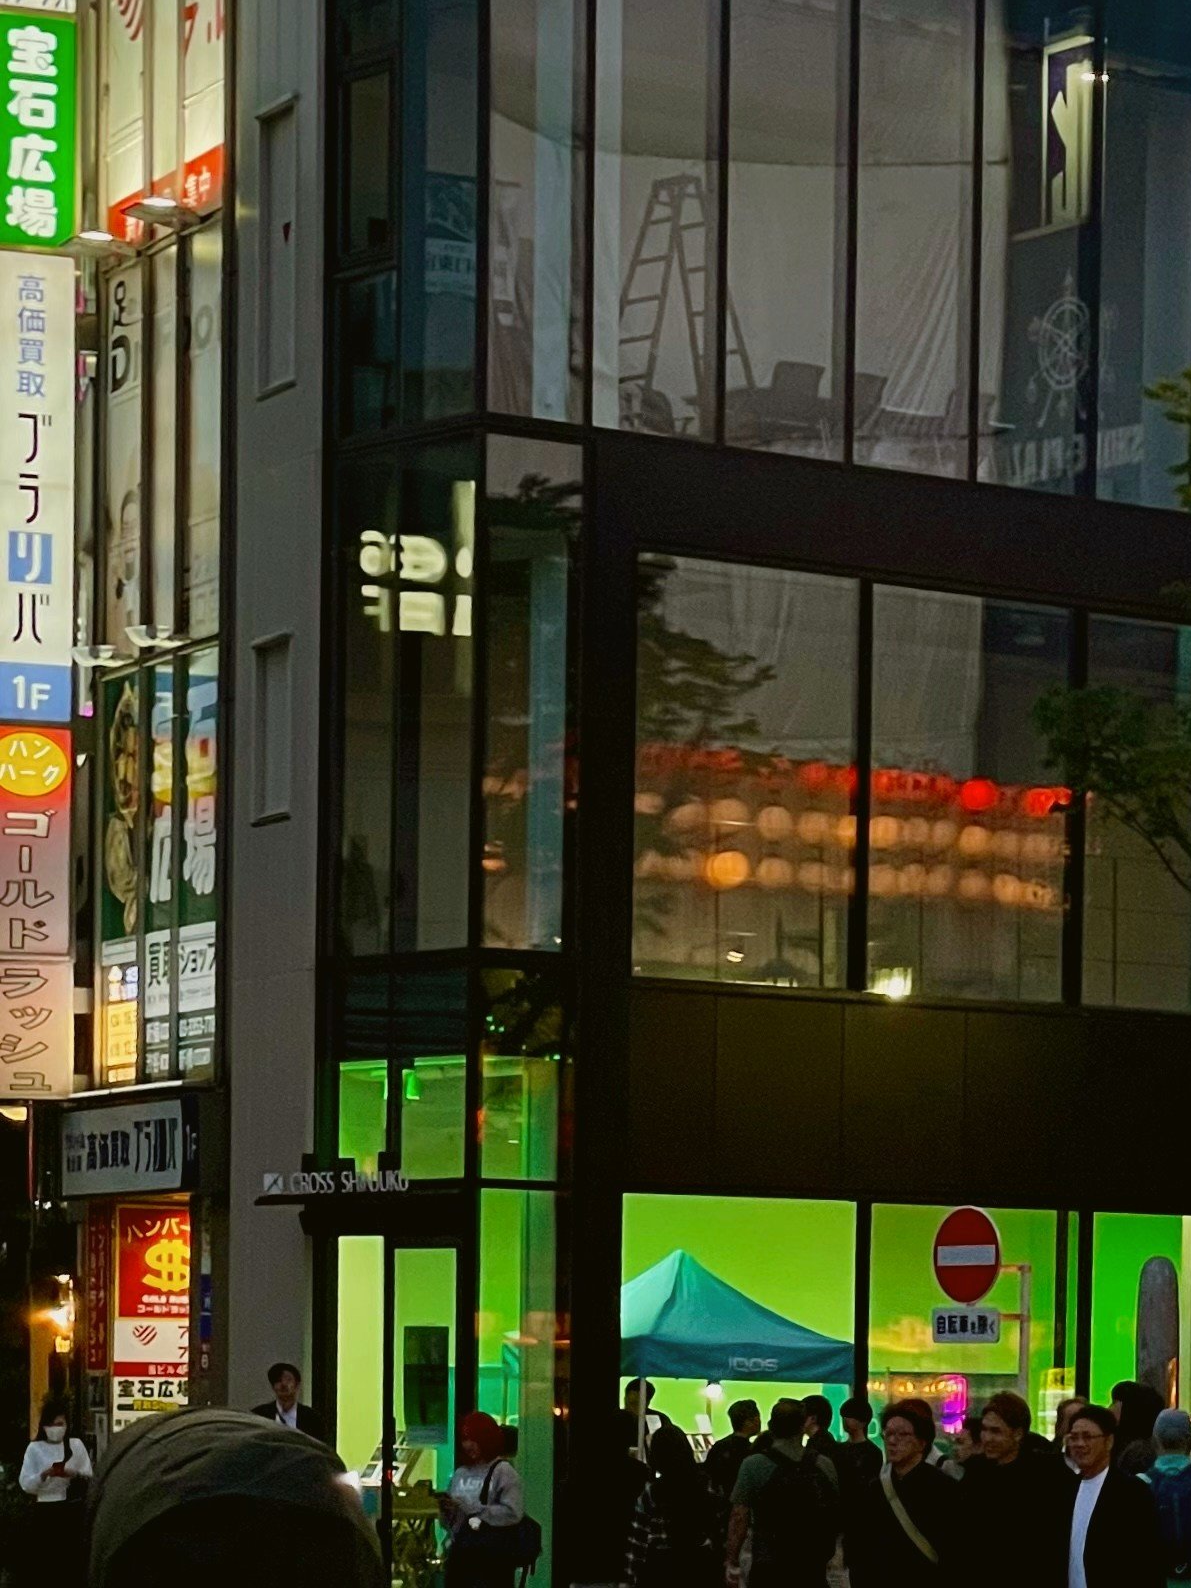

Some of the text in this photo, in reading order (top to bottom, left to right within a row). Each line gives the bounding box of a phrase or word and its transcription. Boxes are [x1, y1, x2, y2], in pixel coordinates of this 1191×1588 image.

[6, 26, 58, 237] 宝石広場
[17, 273, 47, 398] 高価買取
[12, 674, 52, 711] 1F
